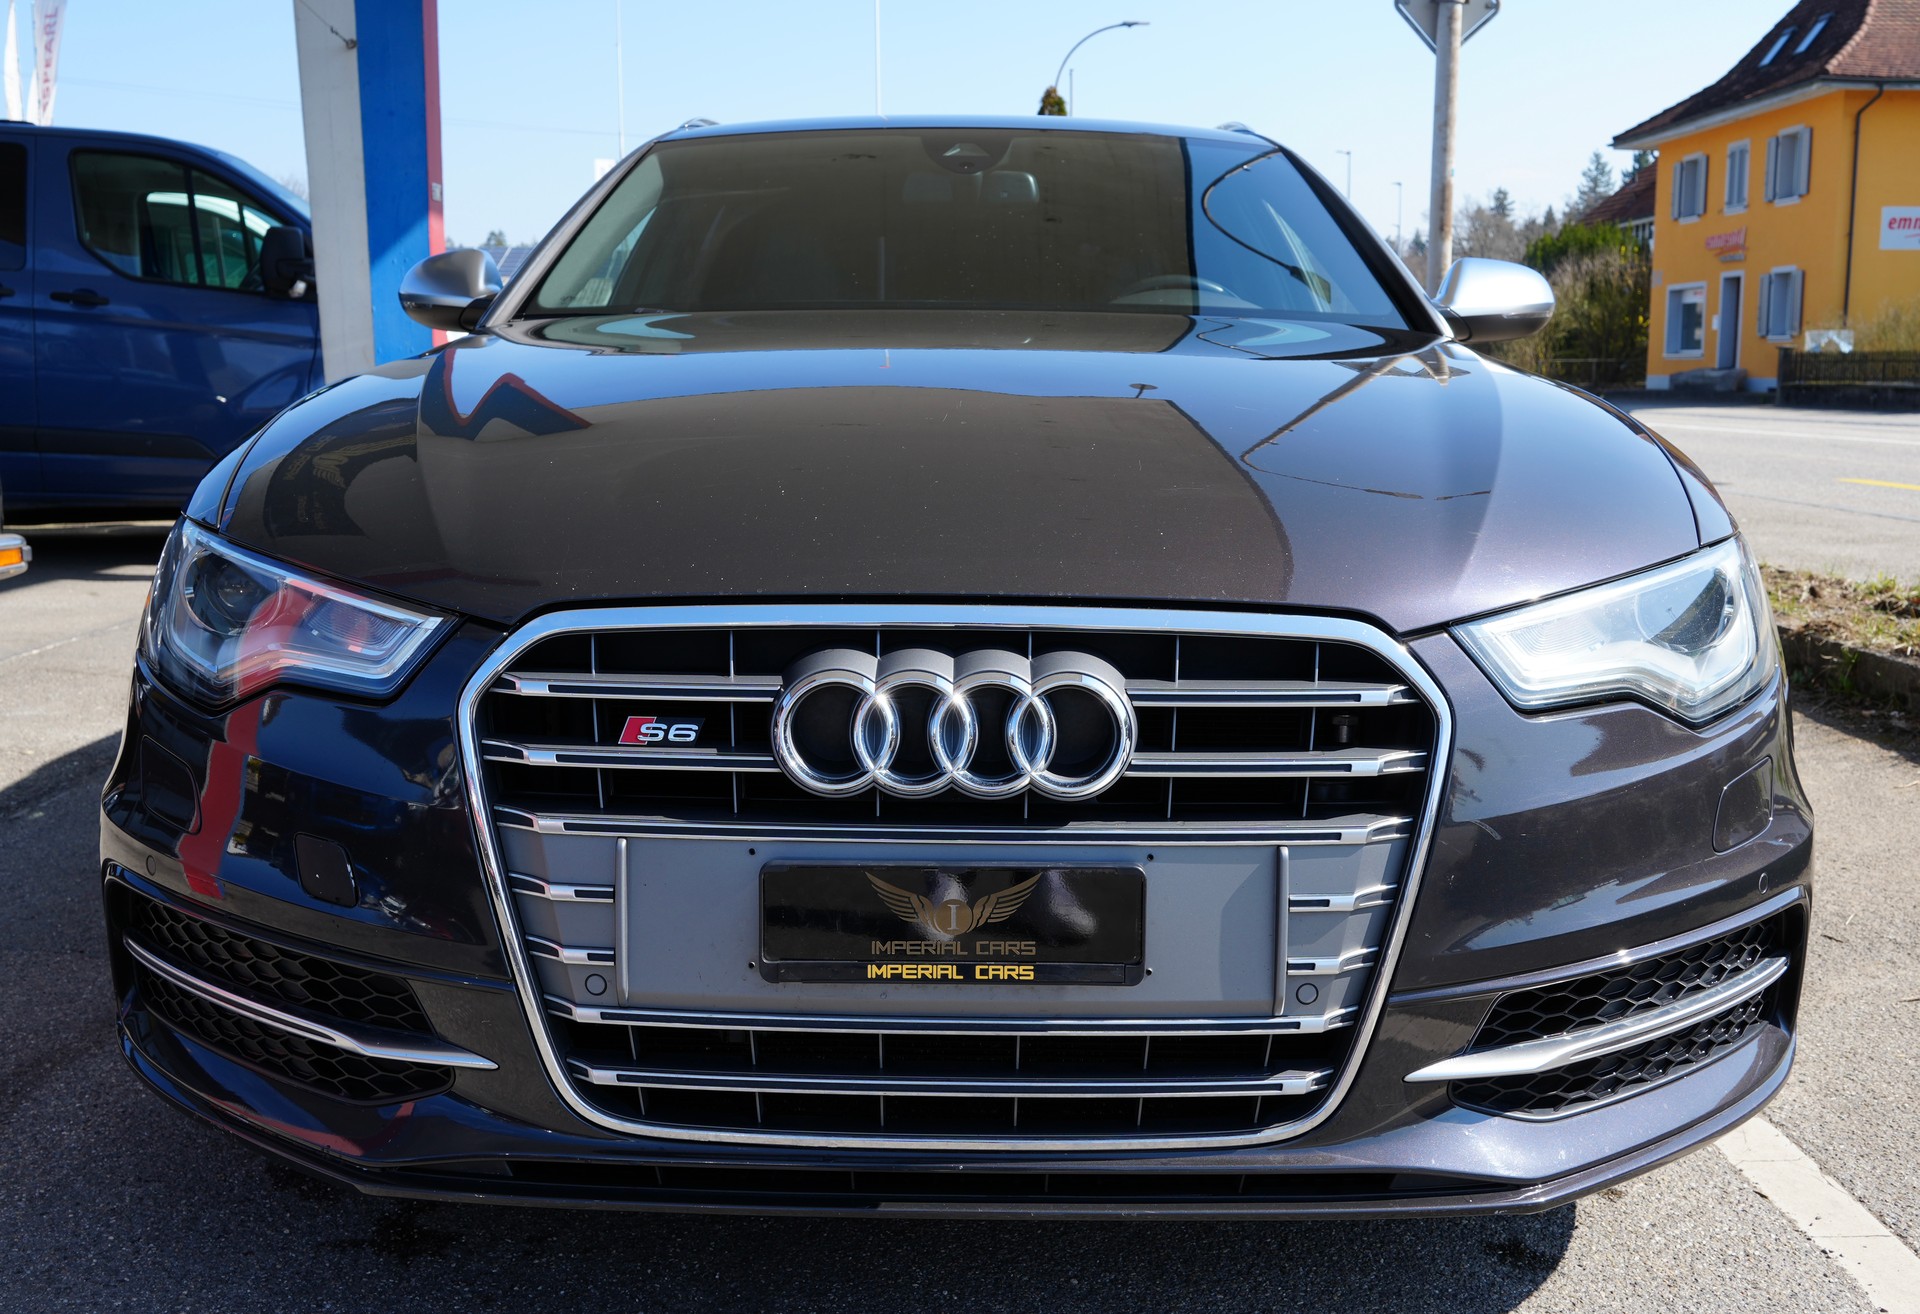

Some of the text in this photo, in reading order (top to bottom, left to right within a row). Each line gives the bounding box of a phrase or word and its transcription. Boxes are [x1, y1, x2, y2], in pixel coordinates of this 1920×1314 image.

[637, 723, 699, 742] S6
[871, 940, 1037, 956] IMPERIAL CARS
[867, 964, 1035, 980] IMPERIAL CARS
